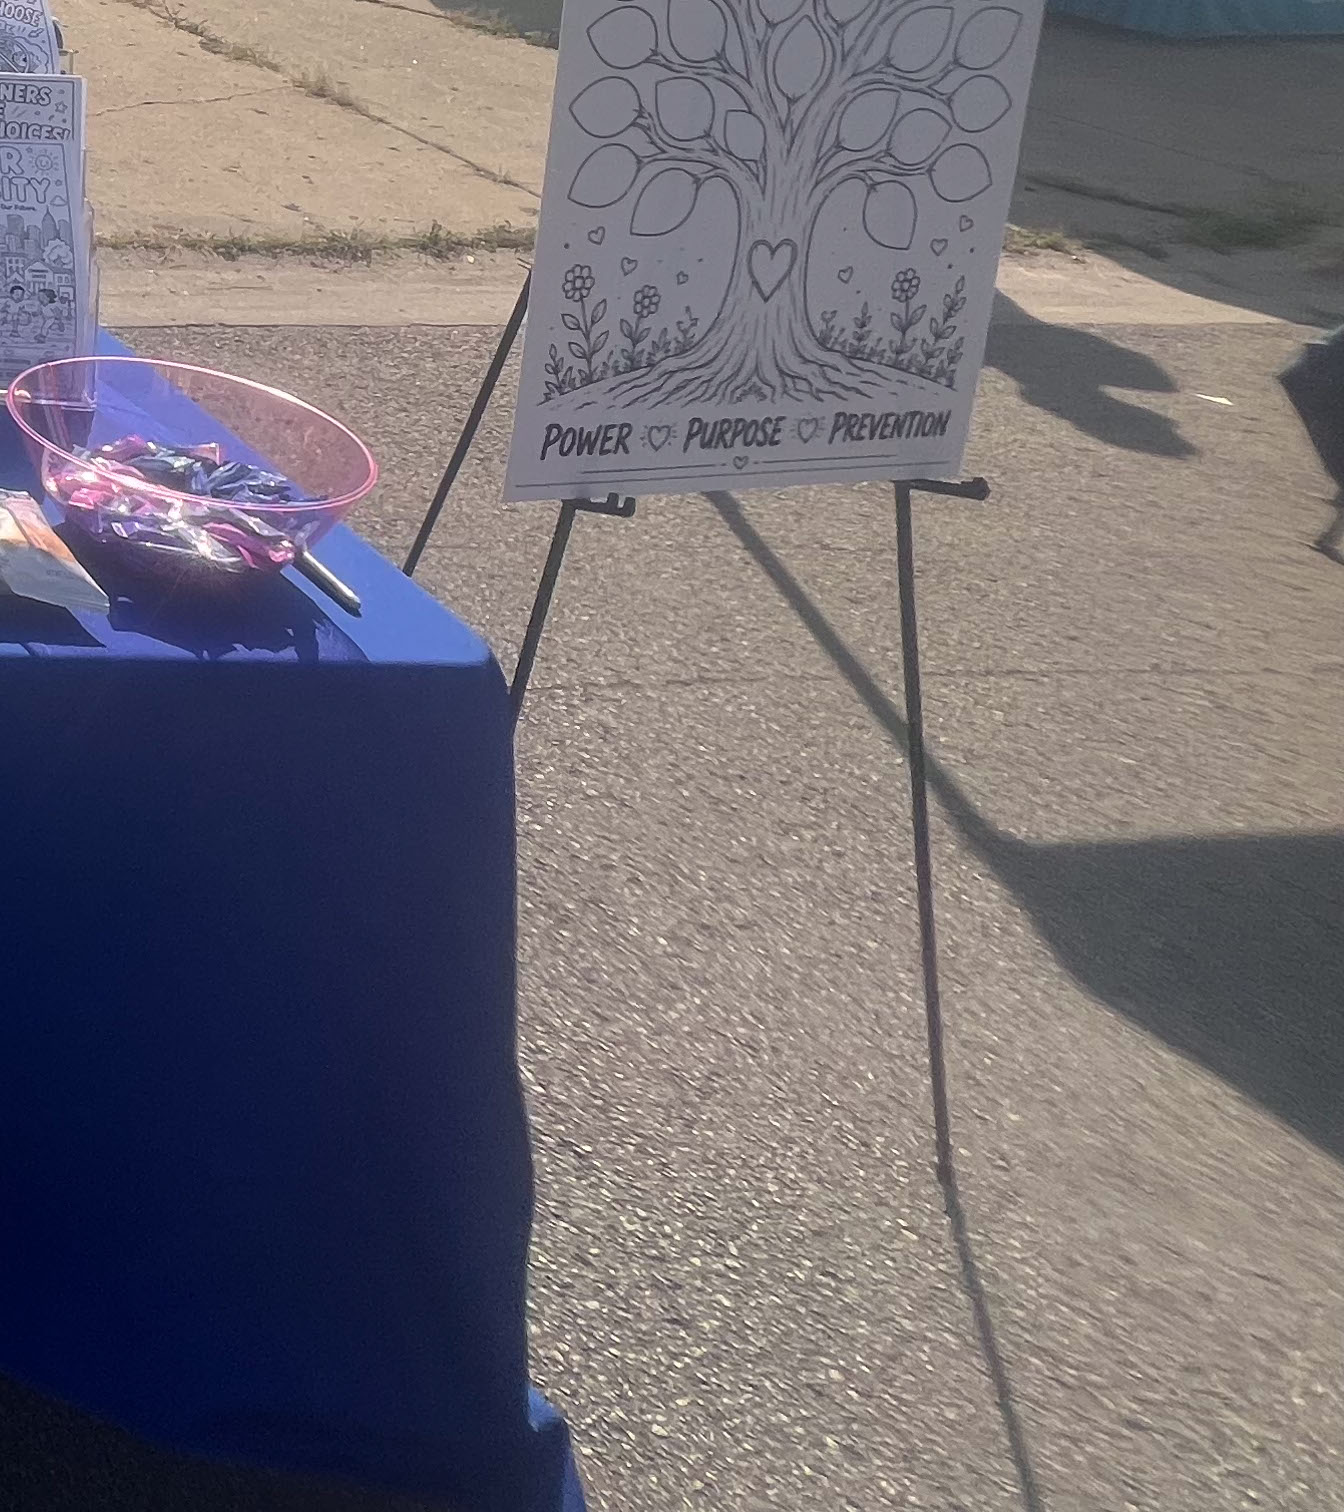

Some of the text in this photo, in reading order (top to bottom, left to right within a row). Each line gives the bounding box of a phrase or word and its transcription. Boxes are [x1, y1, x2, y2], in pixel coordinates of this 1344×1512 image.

[541, 409, 952, 460] POWER PURPOSE PREVENTION
